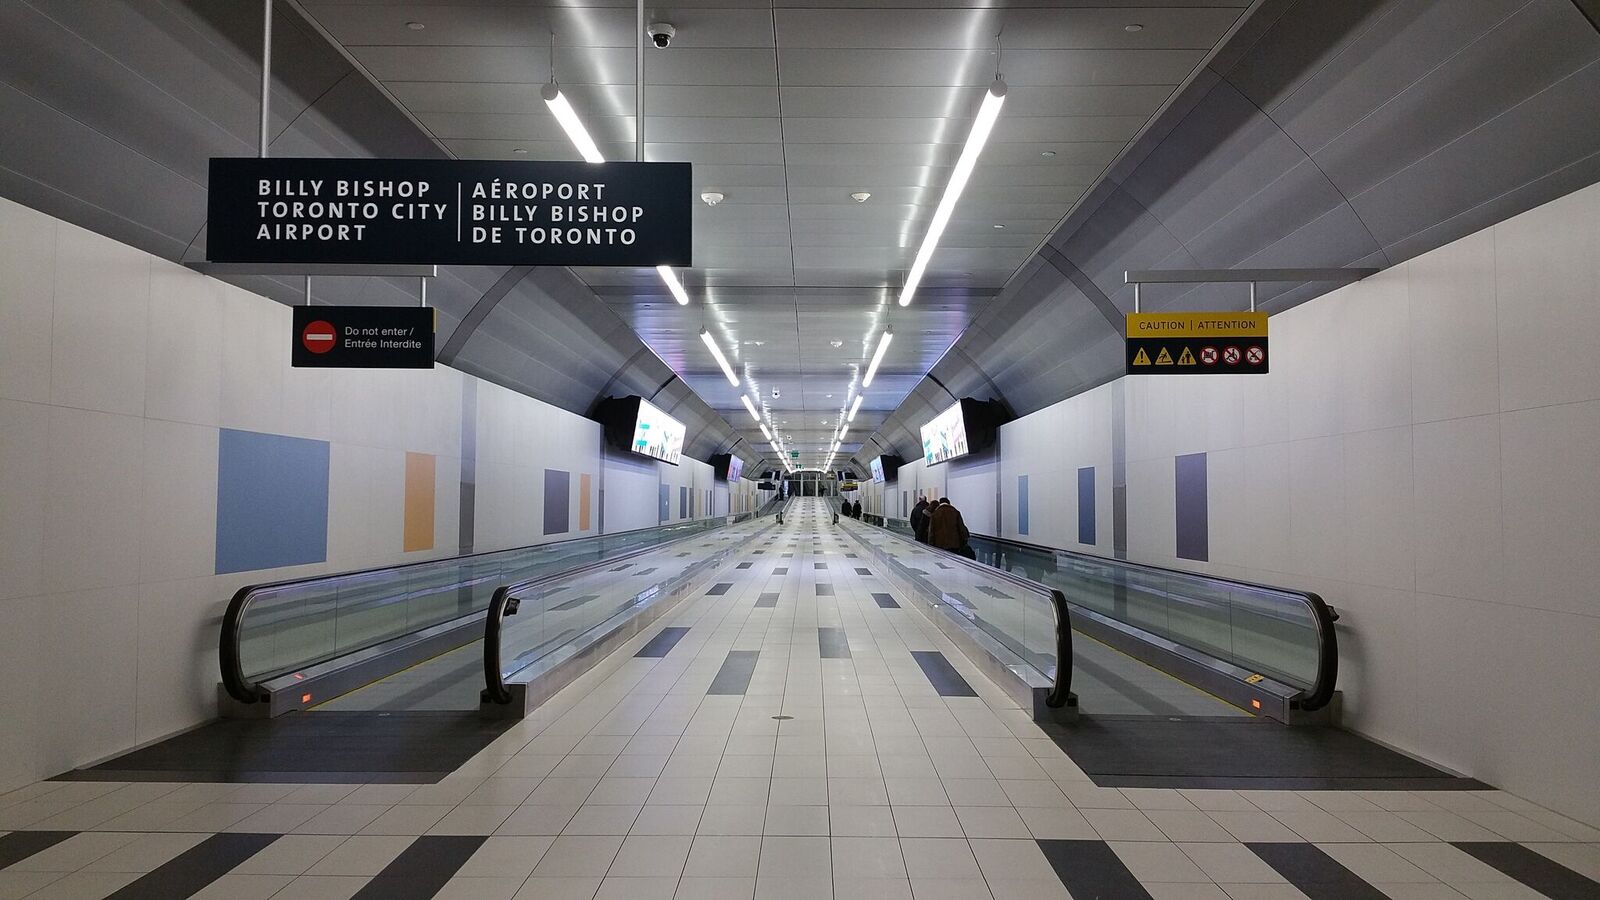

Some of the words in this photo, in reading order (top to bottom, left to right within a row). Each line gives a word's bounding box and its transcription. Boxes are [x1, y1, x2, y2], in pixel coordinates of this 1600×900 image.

[257, 179, 324, 196] BILLY
[336, 180, 430, 198] BISHOP
[471, 178, 606, 200] AÉROPORT
[257, 201, 379, 219] TORONTO
[391, 202, 448, 220] CITY
[472, 204, 538, 222] BILLY
[551, 205, 644, 223] BISHOP
[256, 223, 366, 241] AIRPORT
[472, 226, 502, 244] DE
[514, 227, 636, 245] TORONTO
[344, 326, 360, 336] Do
[362, 327, 379, 336] not
[381, 327, 408, 336] enter
[1139, 321, 1185, 330] CAUTION
[1197, 319, 1256, 329] ATTENTION
[344, 338, 377, 348] Entrée
[380, 339, 422, 349] Interdite
